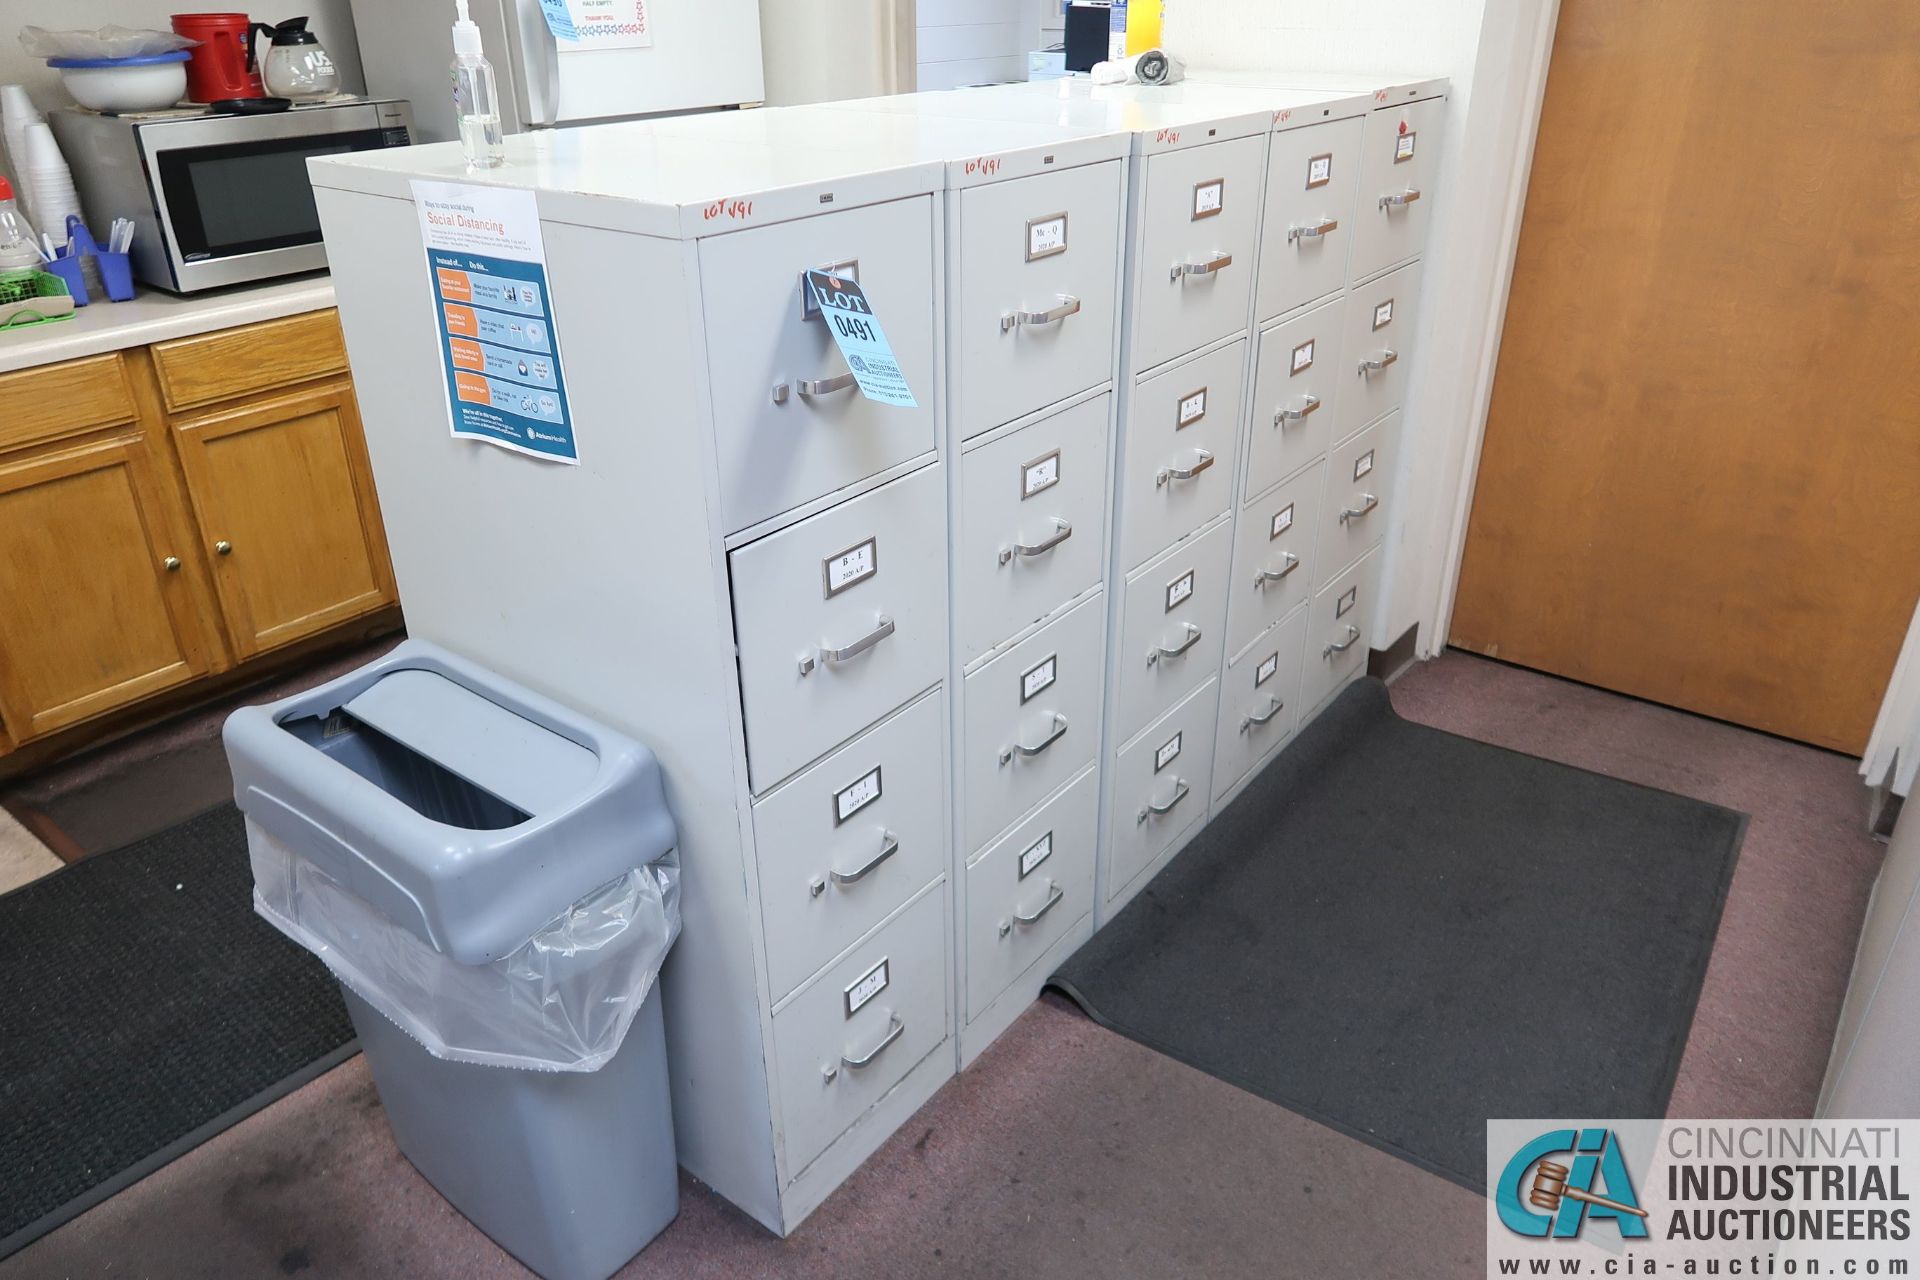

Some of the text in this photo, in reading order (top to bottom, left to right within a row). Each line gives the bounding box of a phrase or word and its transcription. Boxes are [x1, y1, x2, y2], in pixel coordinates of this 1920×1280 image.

[427, 212, 504, 235] Social Distancing
[819, 287, 865, 312] LOT
[834, 314, 876, 342] 0491
[842, 557, 849, 566] B
[858, 550, 864, 560] E
